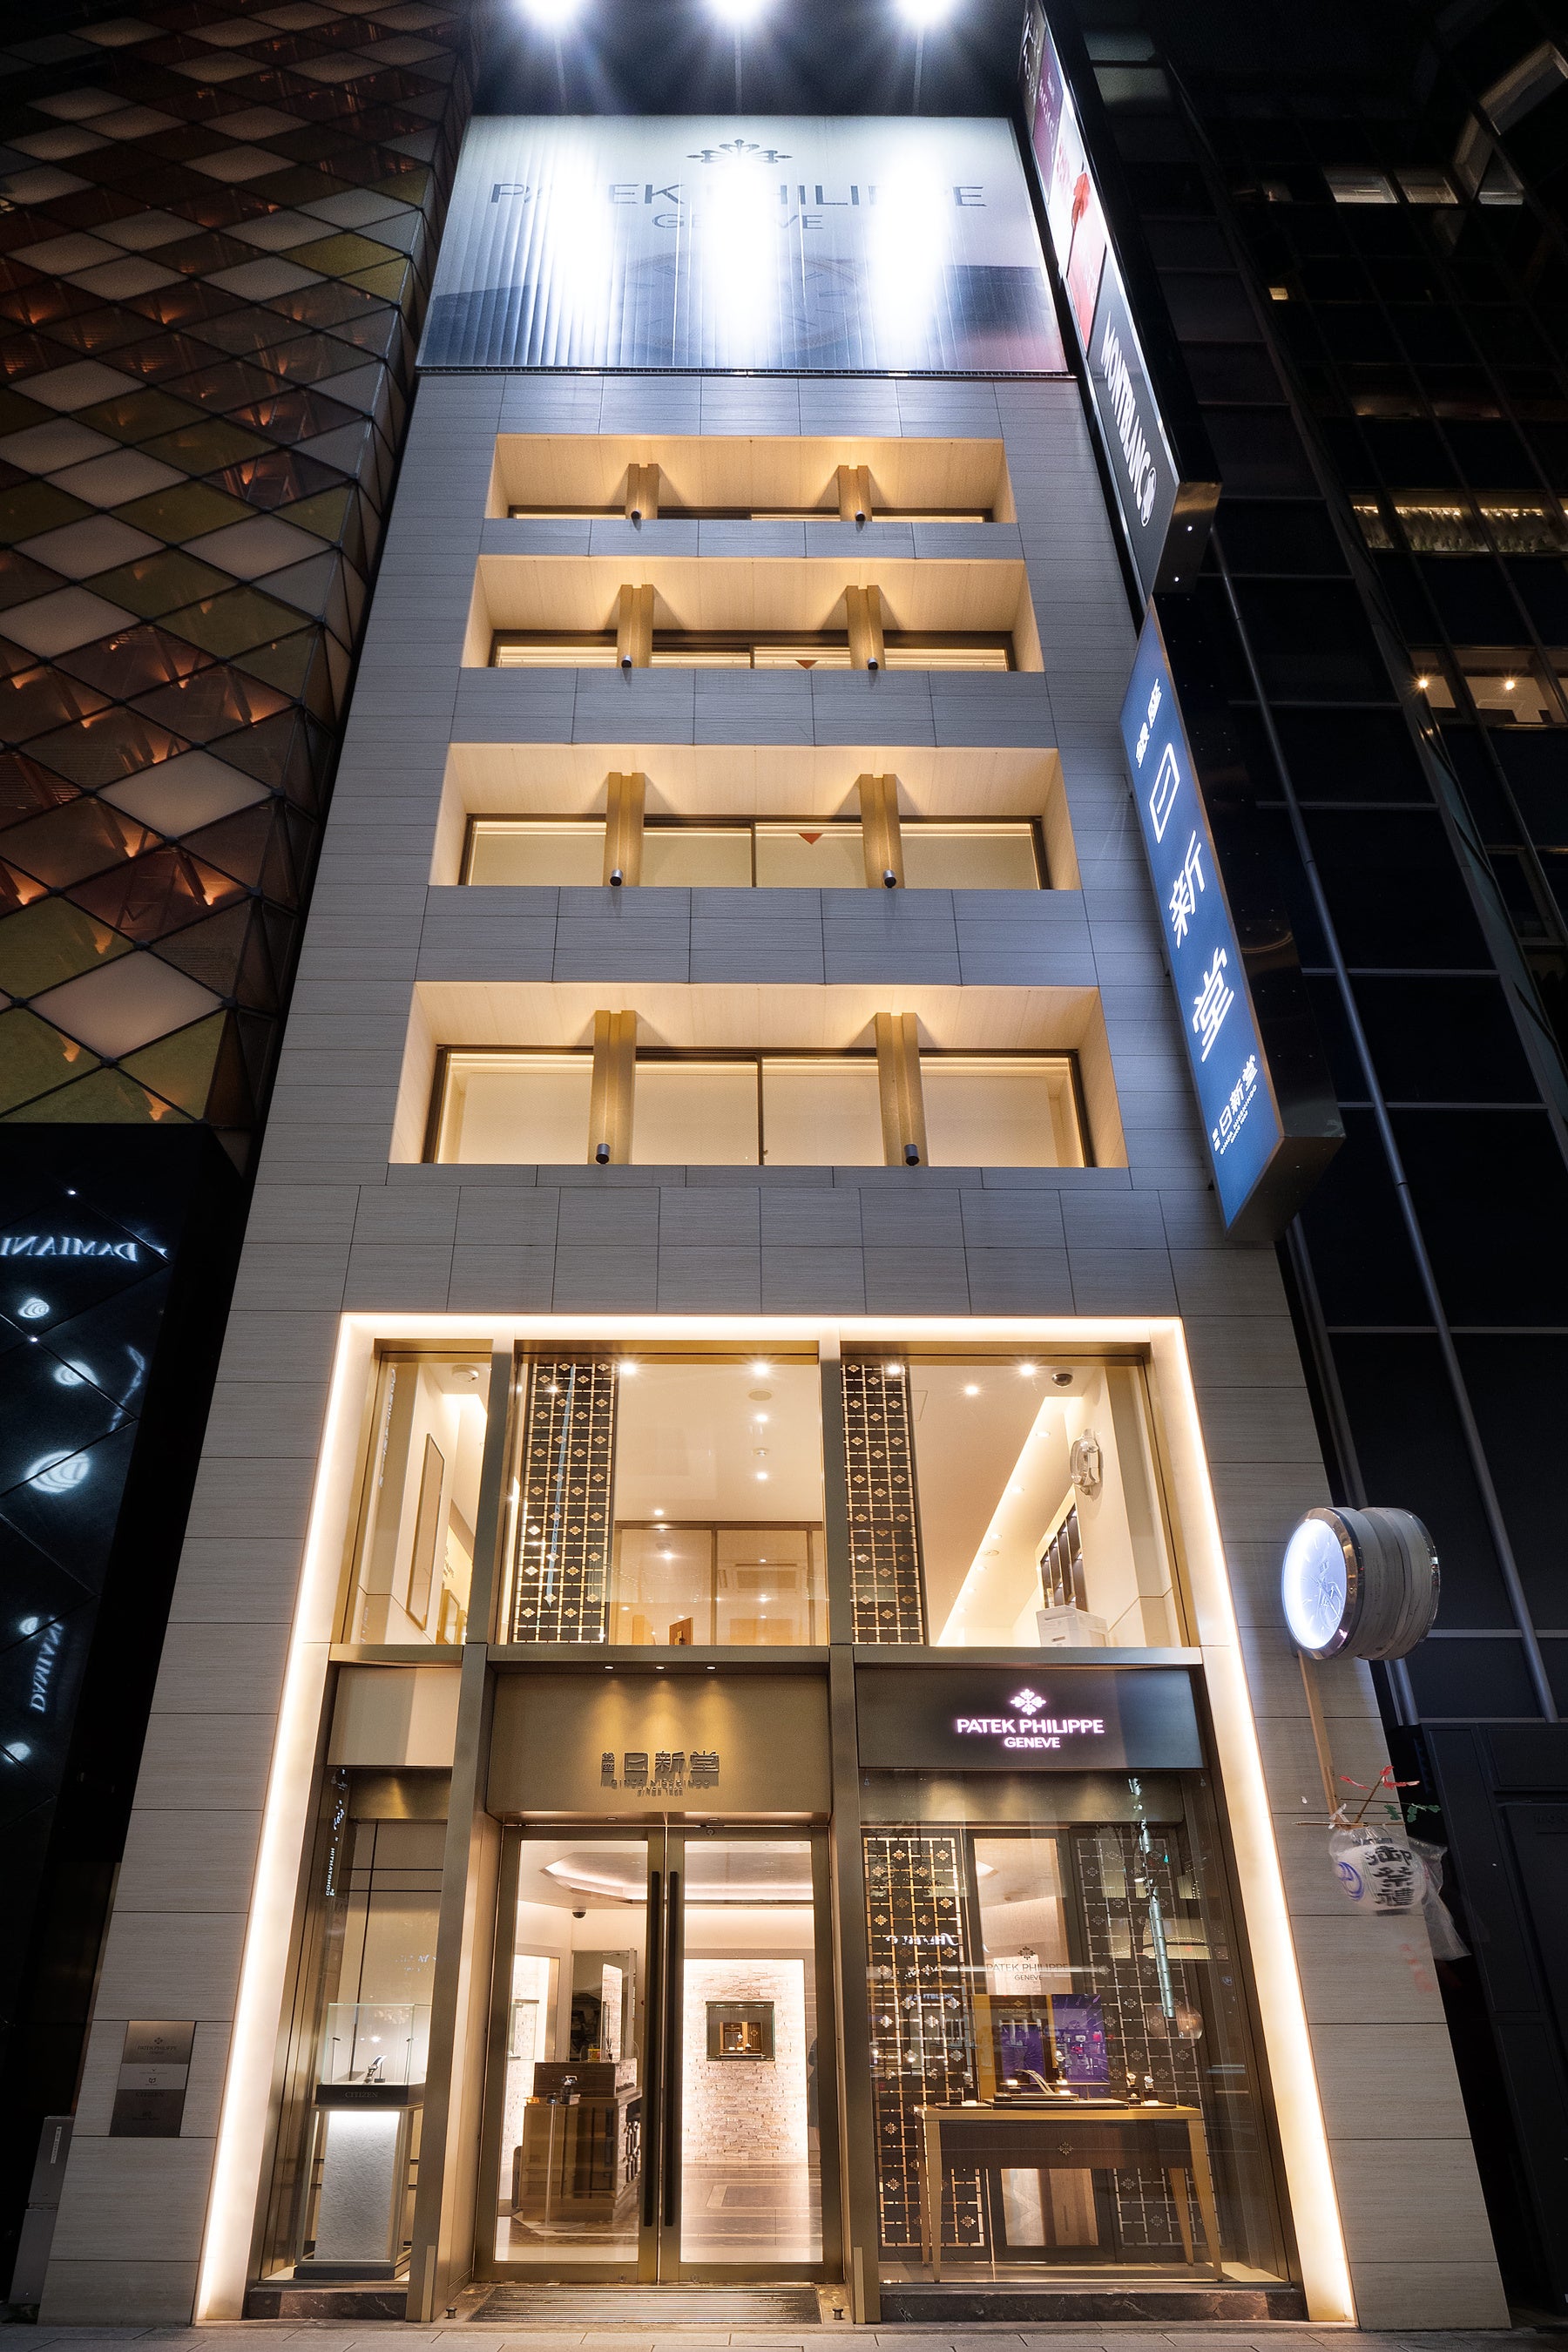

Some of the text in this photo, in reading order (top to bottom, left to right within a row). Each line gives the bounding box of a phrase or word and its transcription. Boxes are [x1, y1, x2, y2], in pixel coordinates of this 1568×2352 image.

[1100, 311, 1151, 510] MONTBLANC
[1149, 742, 1234, 1062] 日新堂
[957, 1719, 1105, 1734] PATEK PHILIPPE
[1004, 1737, 1060, 1748] GENEVE
[624, 1750, 720, 1773] 日新堂
[986, 1963, 1018, 1971] PATEK
